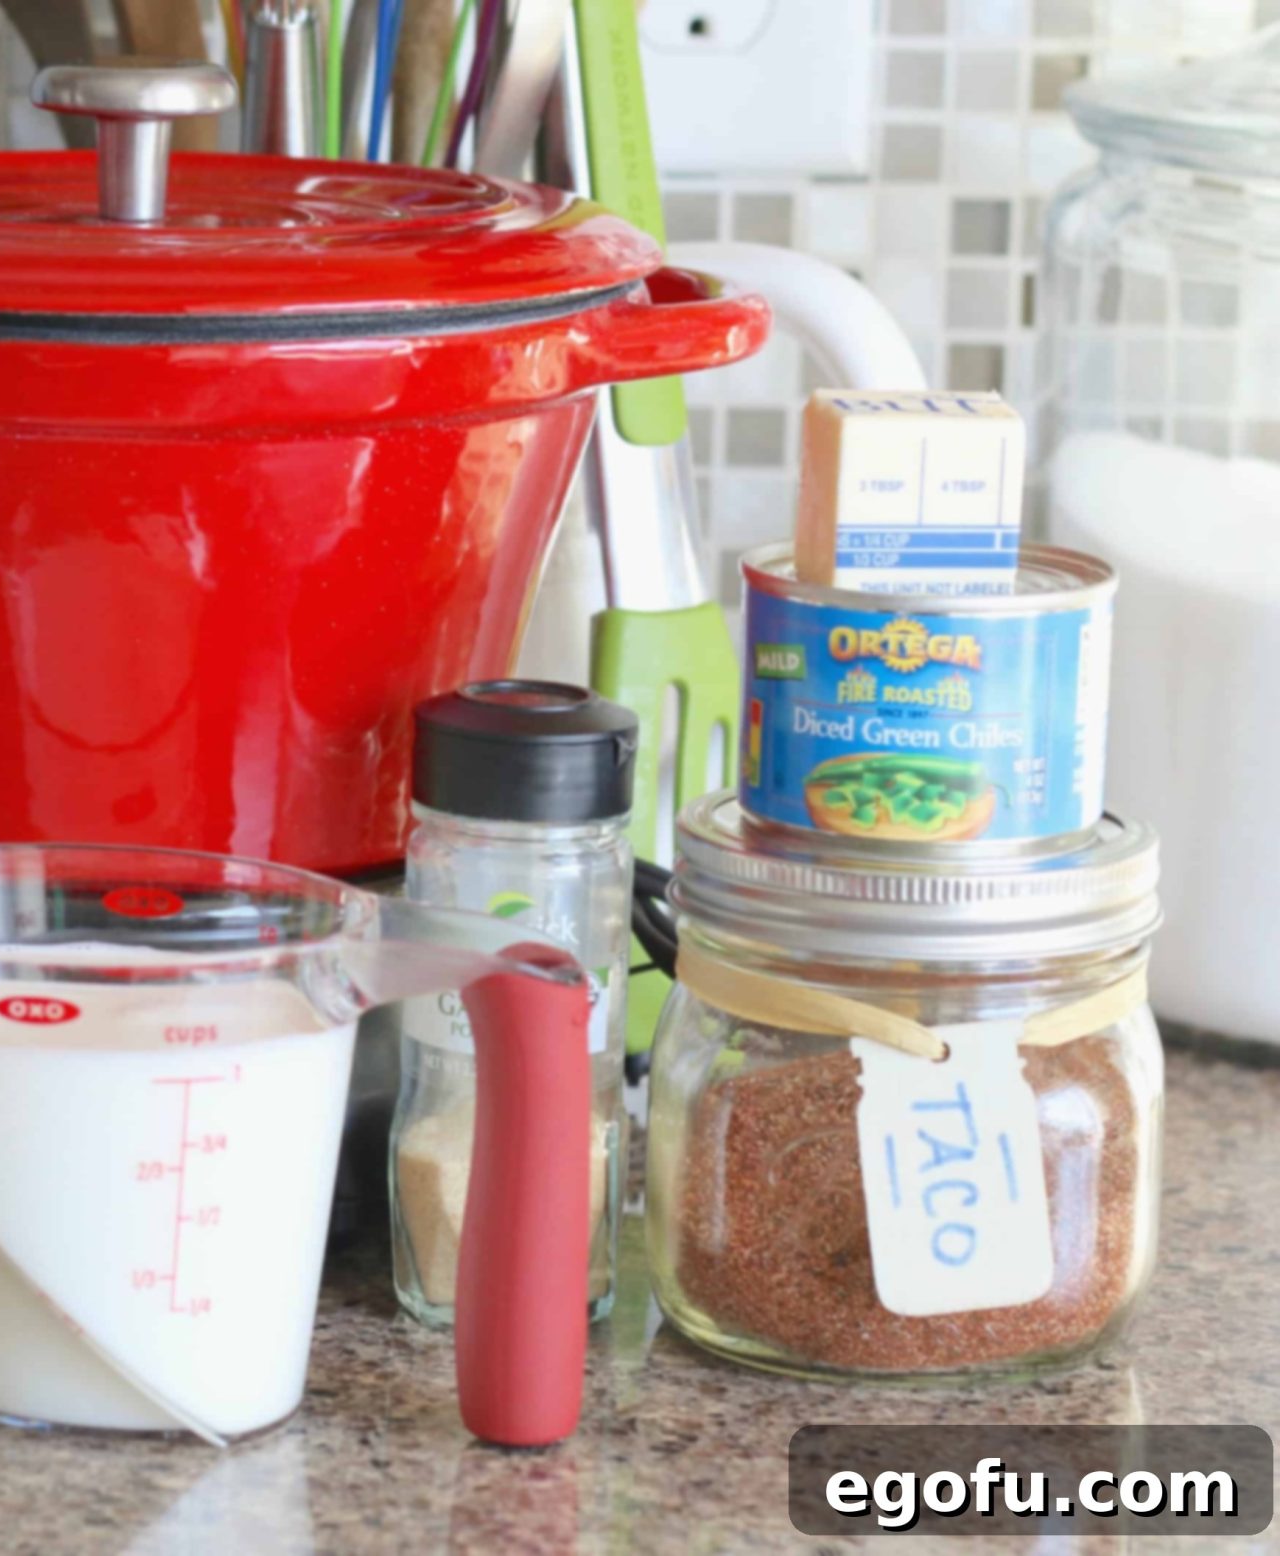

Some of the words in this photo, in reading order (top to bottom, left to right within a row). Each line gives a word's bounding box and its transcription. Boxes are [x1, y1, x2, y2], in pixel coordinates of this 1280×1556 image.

[883, 533, 911, 547] CUP
[872, 554, 900, 568] CUP
[925, 582, 953, 596] NOT
[828, 626, 982, 672] ORTEGA
[756, 652, 801, 672] MILD
[837, 676, 877, 704] FIRE
[882, 678, 973, 712] ROASTED
[792, 706, 856, 741] Diced
[861, 717, 940, 748] Green
[948, 721, 1025, 749] Chiles
[7, 998, 65, 1022] OXO
[163, 1025, 218, 1046] cups
[135, 1161, 165, 1183] 2/3
[911, 1081, 980, 1267] TACO
[131, 1270, 157, 1289] 1/3
